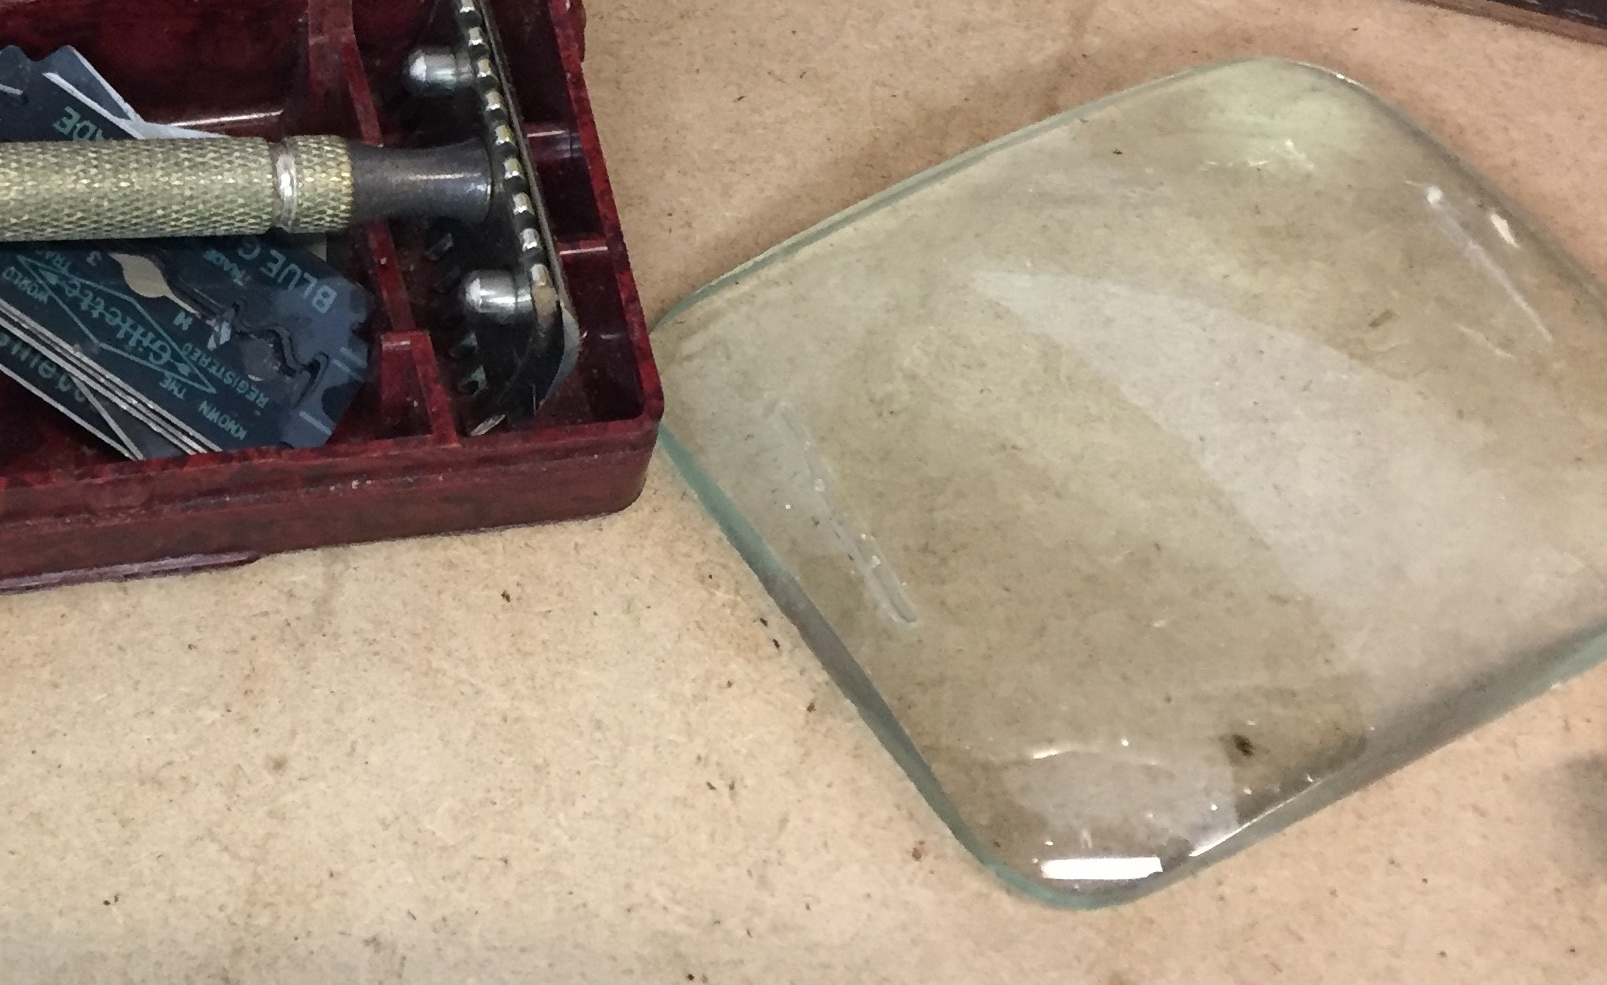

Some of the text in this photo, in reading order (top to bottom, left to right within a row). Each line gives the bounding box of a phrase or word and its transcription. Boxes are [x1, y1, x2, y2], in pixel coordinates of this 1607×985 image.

[1, 266, 51, 305] WORLD
[259, 249, 338, 314] BLUE
[64, 279, 172, 366] Gillette
[158, 371, 188, 400] THE
[181, 342, 270, 409] REGISTERED
[198, 399, 248, 441] KNOWN
